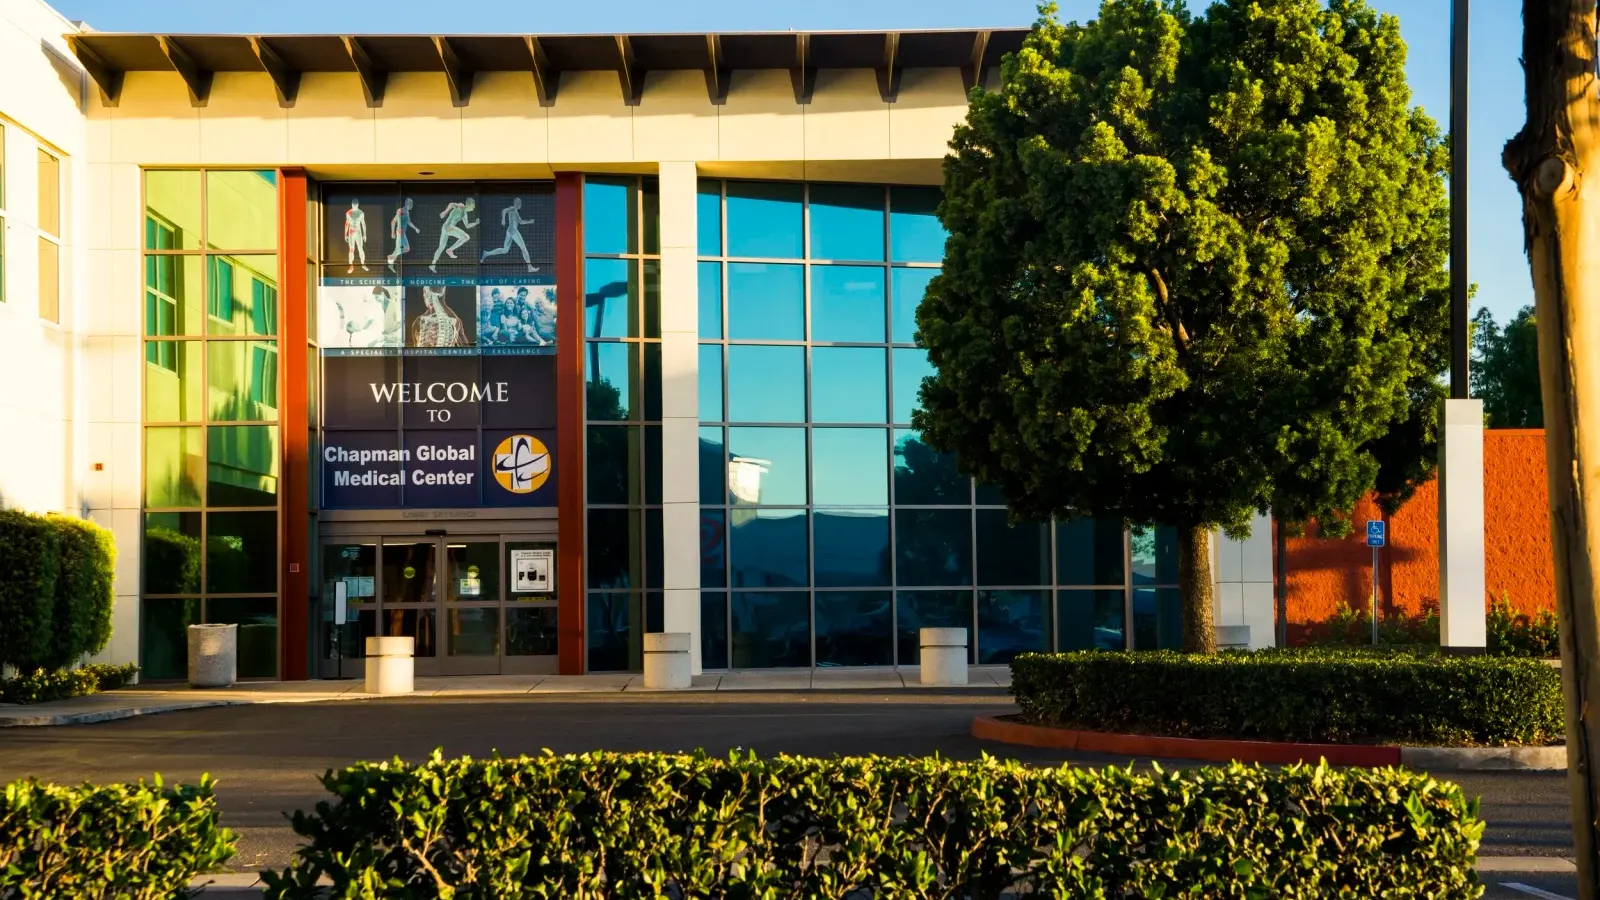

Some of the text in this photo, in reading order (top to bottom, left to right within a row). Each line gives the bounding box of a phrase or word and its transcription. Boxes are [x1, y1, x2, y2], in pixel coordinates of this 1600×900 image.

[369, 382, 509, 403] WELCOME
[426, 409, 451, 422] TO
[324, 445, 475, 465] Chapman Global
[334, 469, 475, 486] Medical Center
